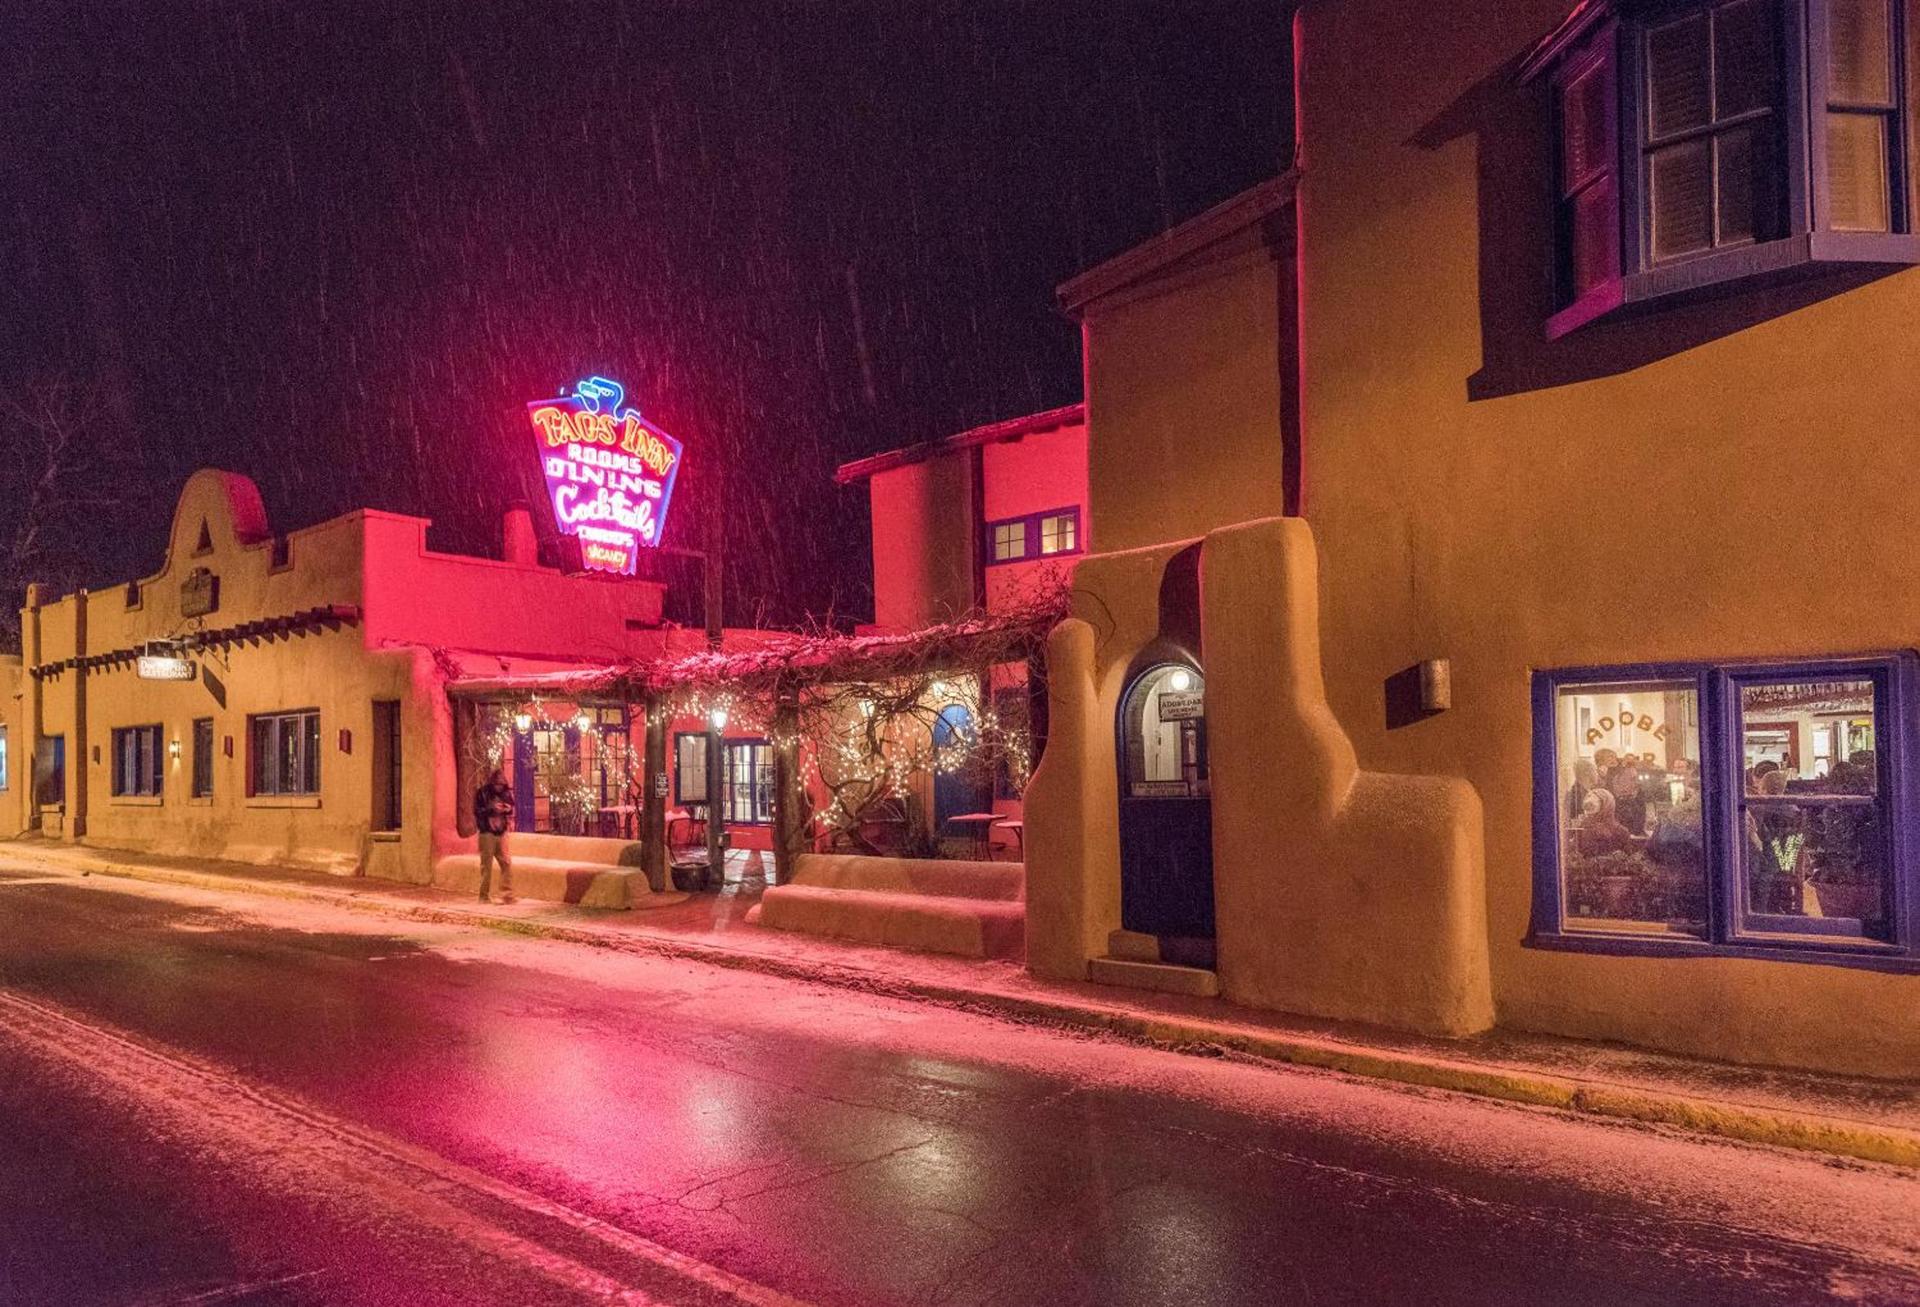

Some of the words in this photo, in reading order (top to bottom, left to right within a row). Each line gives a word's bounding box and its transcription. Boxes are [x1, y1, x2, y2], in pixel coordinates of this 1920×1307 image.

[534, 407, 617, 447] TAOS
[620, 415, 676, 475] INN
[568, 443, 642, 474] ROOMS
[545, 457, 662, 498] DINING
[556, 484, 655, 540] Cocktails
[587, 544, 627, 567] VACANCY
[1586, 711, 1671, 745] ADOBE
